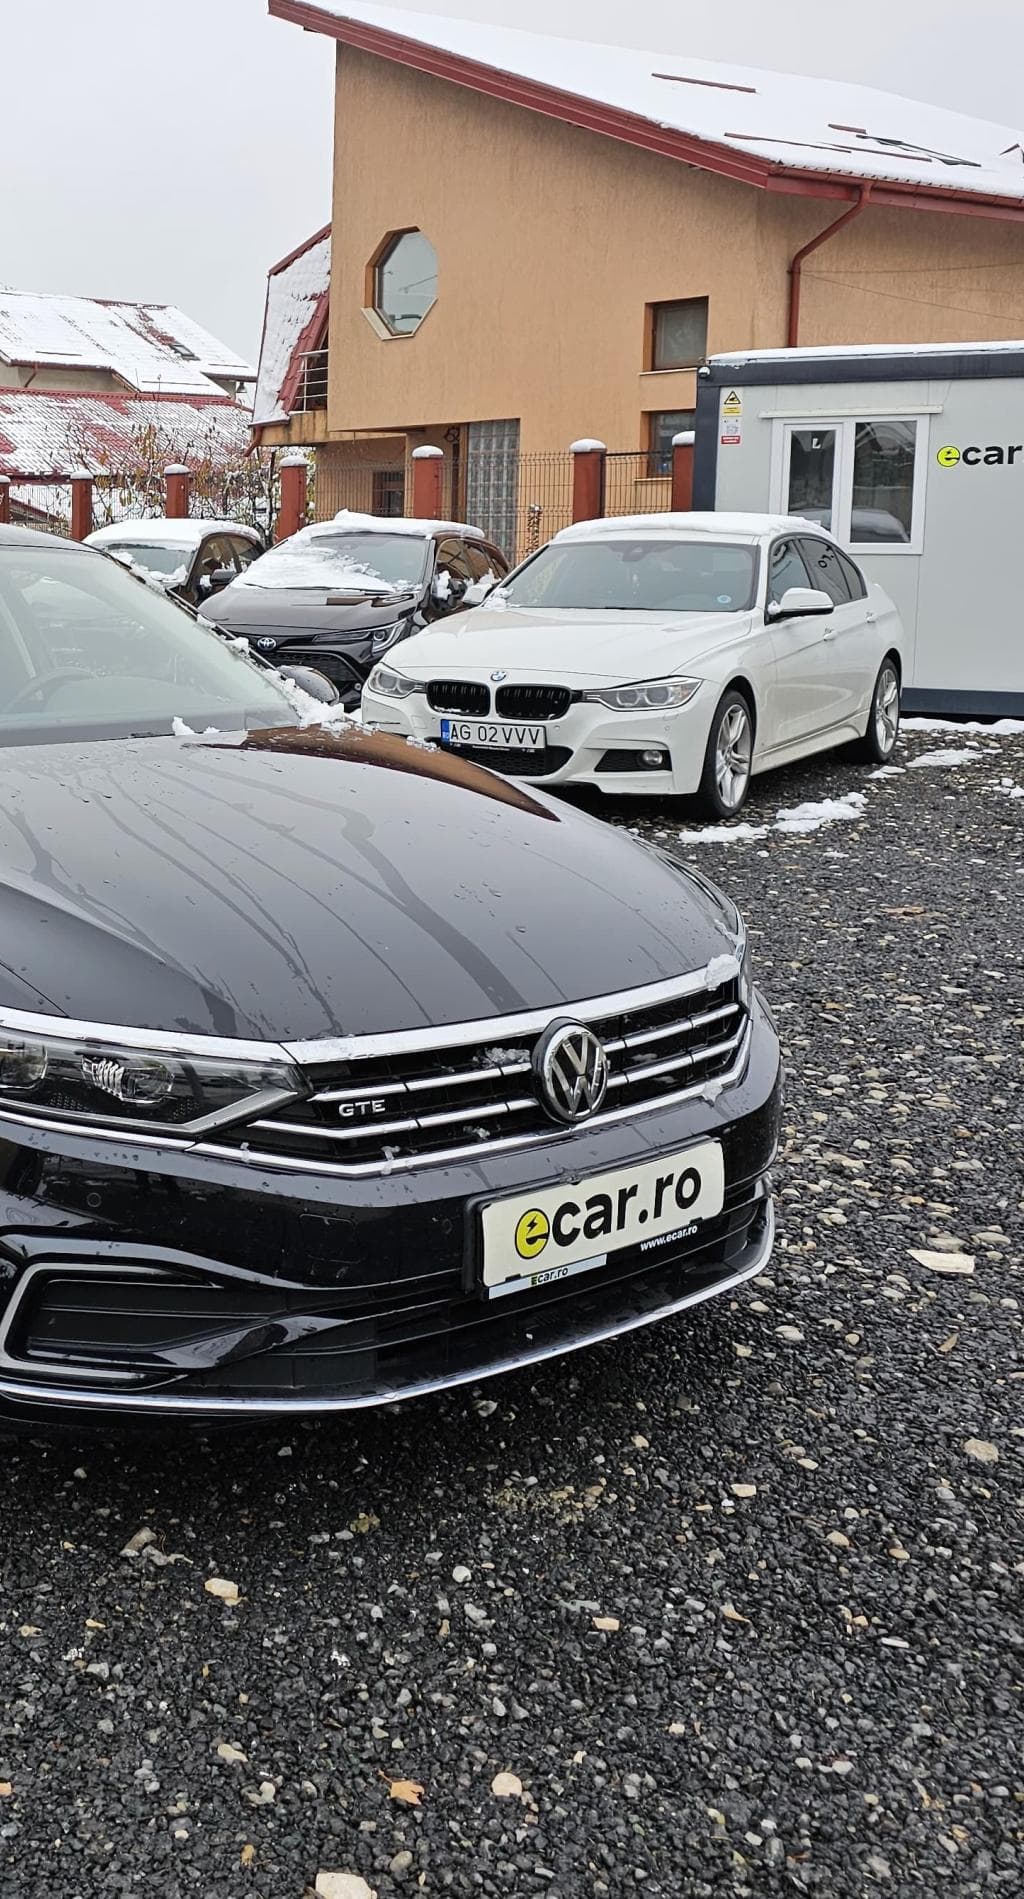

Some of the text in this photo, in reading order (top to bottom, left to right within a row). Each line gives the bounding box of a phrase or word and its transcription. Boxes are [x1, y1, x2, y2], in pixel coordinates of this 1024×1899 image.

[450, 723, 471, 741] AG
[478, 725, 498, 742] 02
[501, 727, 540, 745] VVV
[338, 1099, 386, 1117] GTE
[514, 1167, 702, 1259] ecar.ro
[640, 1224, 698, 1251] www.ecar.ro
